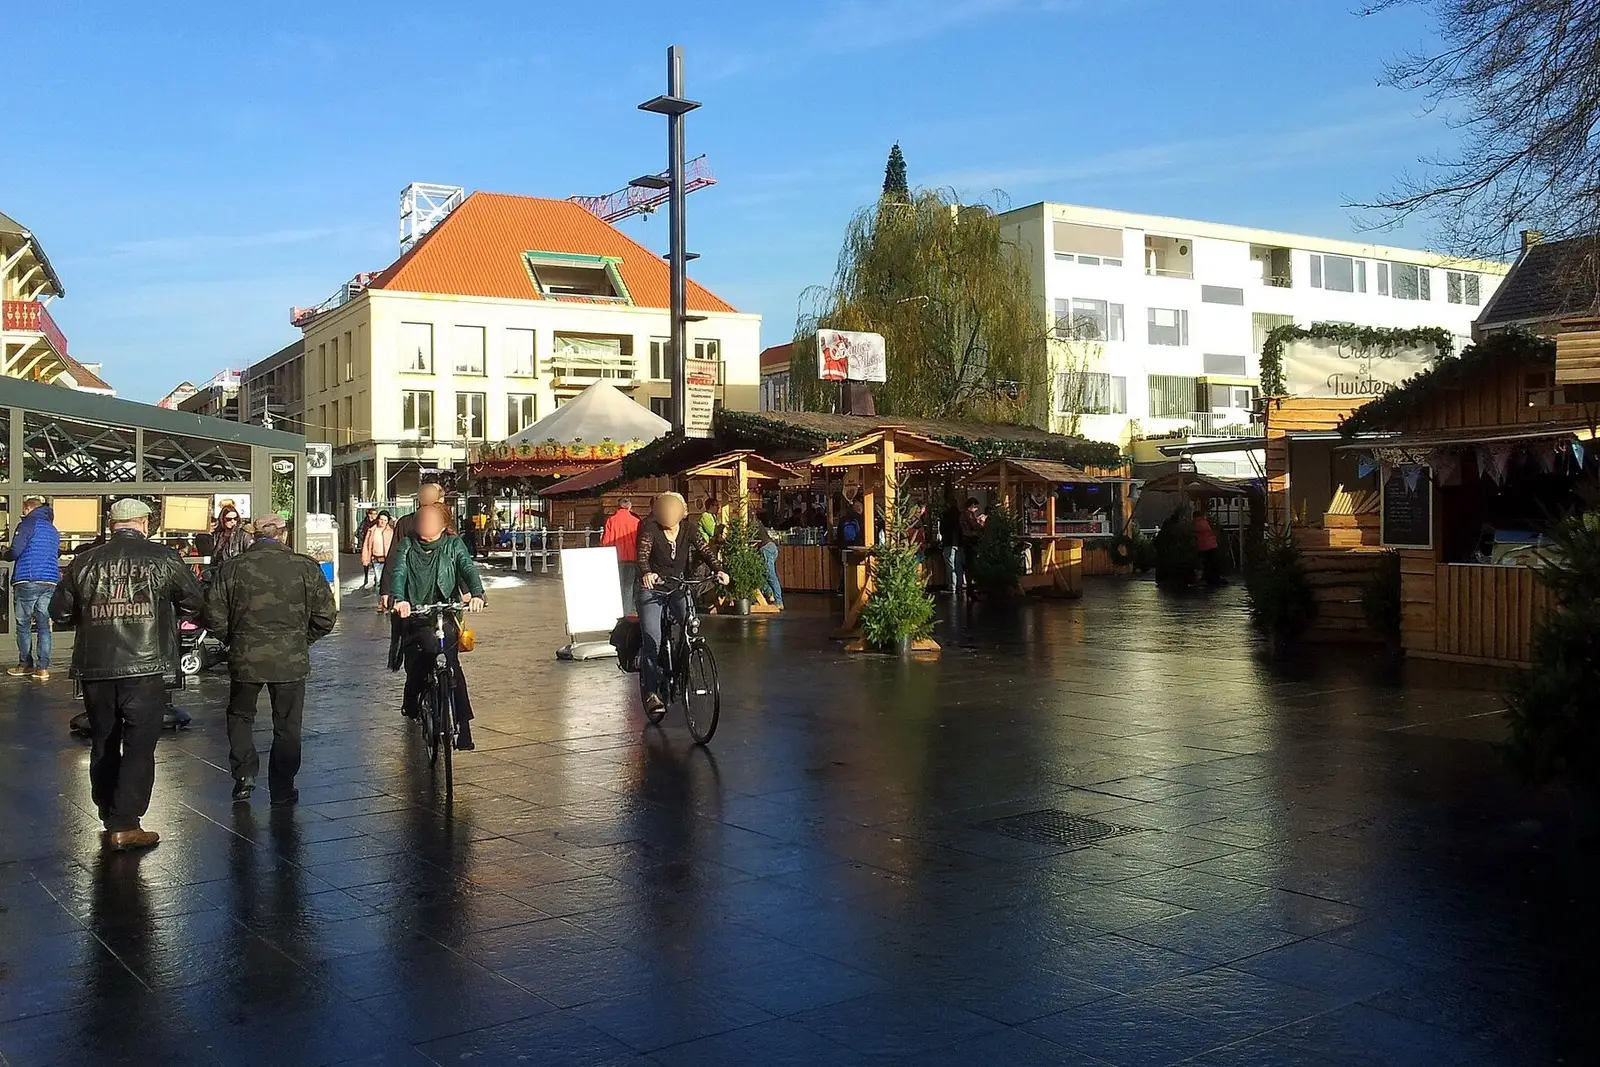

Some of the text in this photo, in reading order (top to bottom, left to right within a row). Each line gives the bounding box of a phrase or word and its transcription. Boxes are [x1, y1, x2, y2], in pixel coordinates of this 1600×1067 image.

[1359, 363, 1368, 375] &
[99, 564, 149, 579] ARLEY
[91, 602, 150, 619] DAVIDSON
